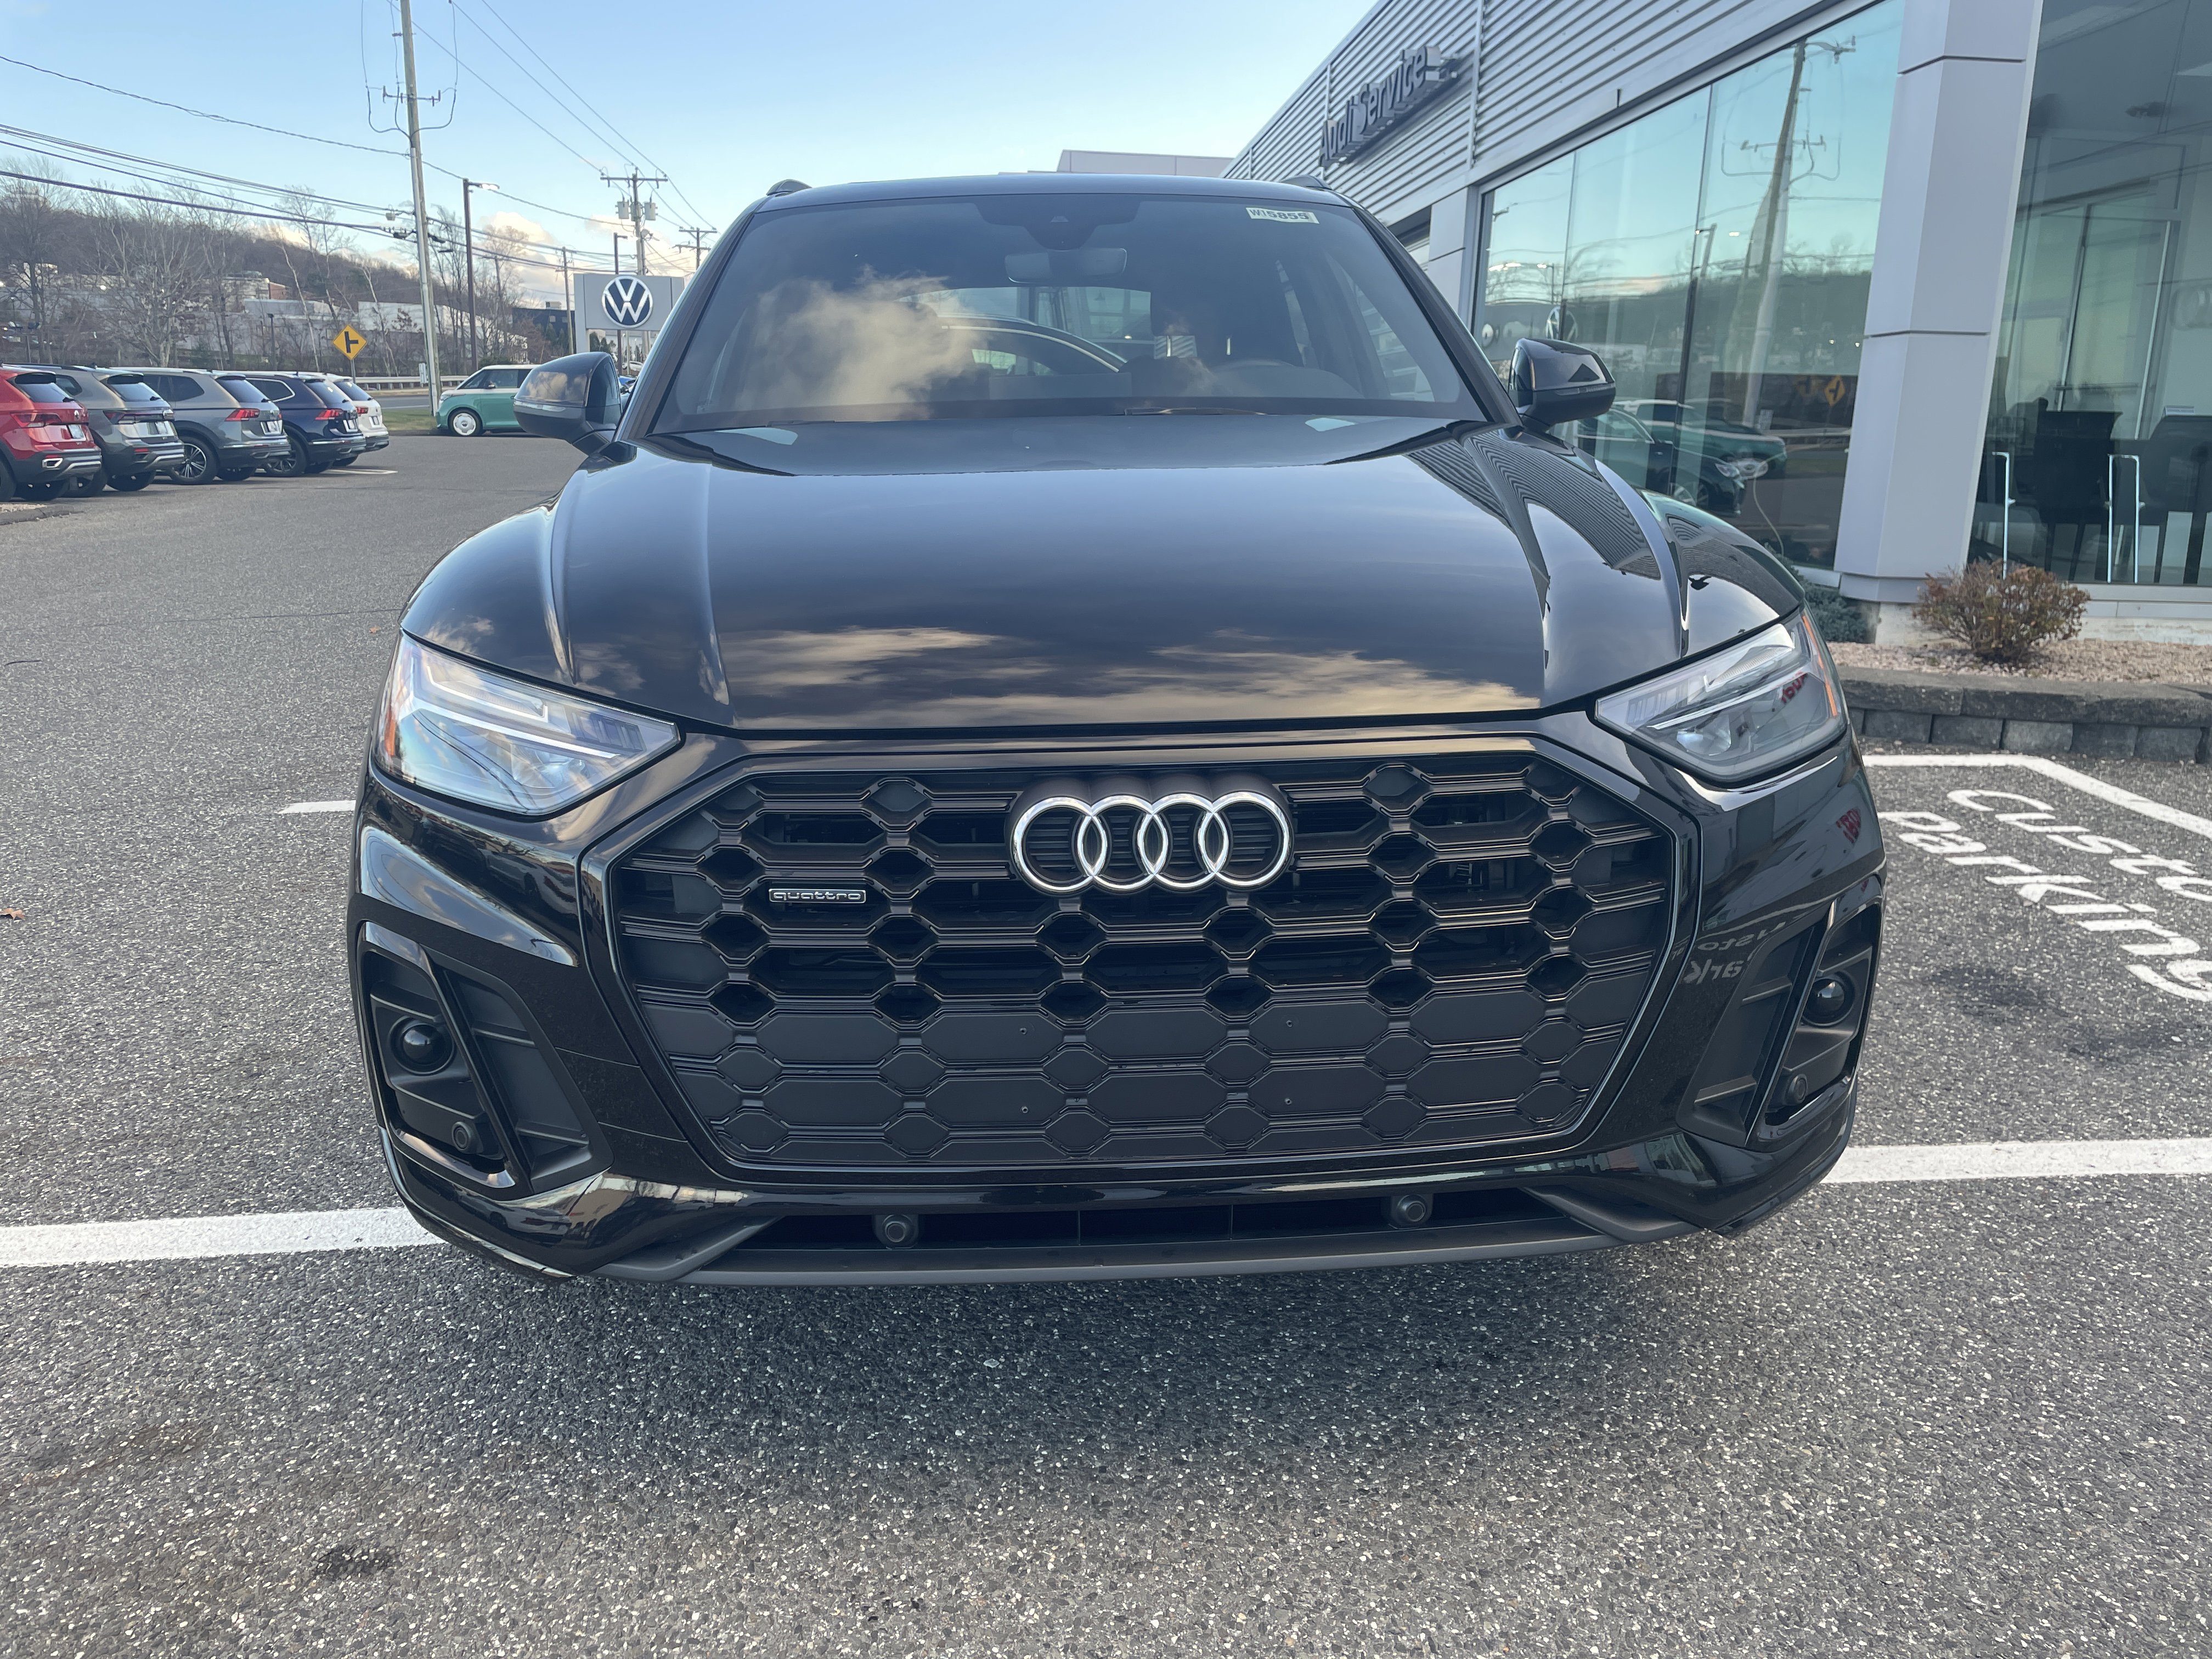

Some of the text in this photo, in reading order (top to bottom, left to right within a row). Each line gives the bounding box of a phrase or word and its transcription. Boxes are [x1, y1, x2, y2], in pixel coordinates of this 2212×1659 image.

[1319, 46, 1440, 163] Audi Service
[602, 275, 652, 328] VW
[773, 890, 861, 901] quattro
[1877, 811, 2212, 1002] Parking
